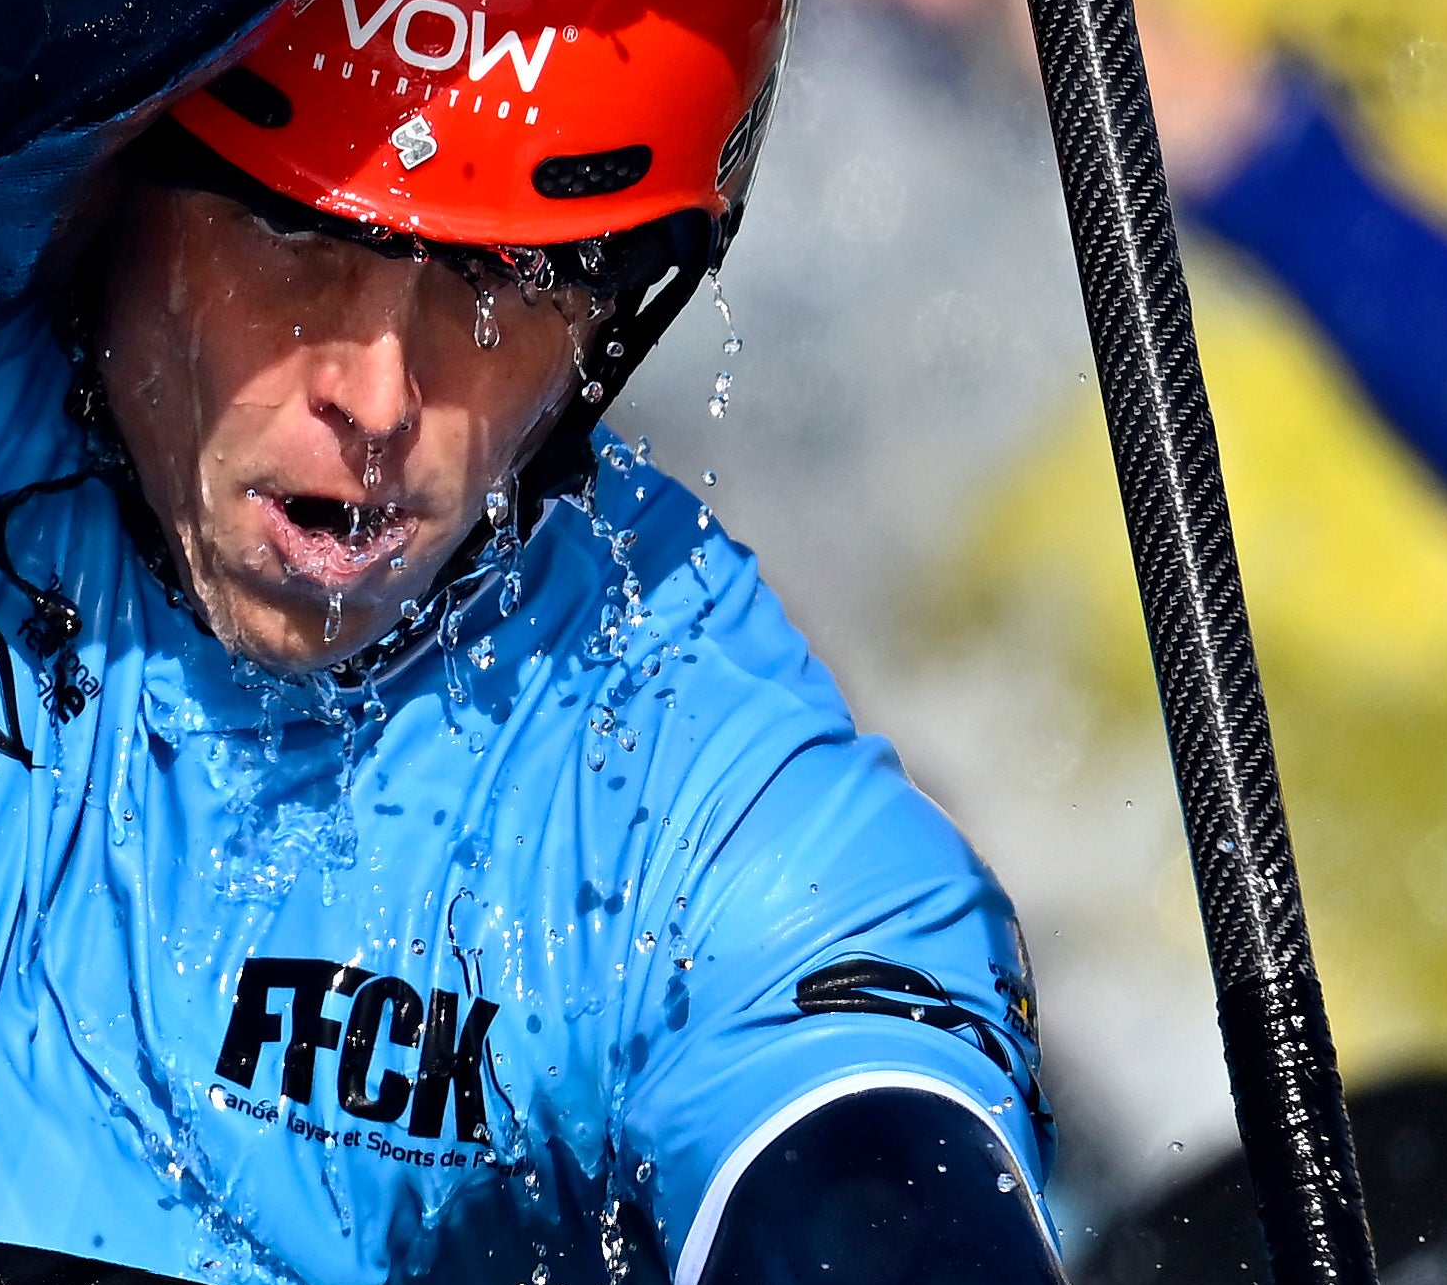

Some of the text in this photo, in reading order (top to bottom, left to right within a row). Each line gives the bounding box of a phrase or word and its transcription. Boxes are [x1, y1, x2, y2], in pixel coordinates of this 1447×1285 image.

[312, 52, 540, 126] NUTRITION
[214, 957, 501, 1147] FFCK
[343, 1130, 363, 1147] et
[366, 1131, 435, 1167] Sports
[440, 1148, 467, 1168] de
